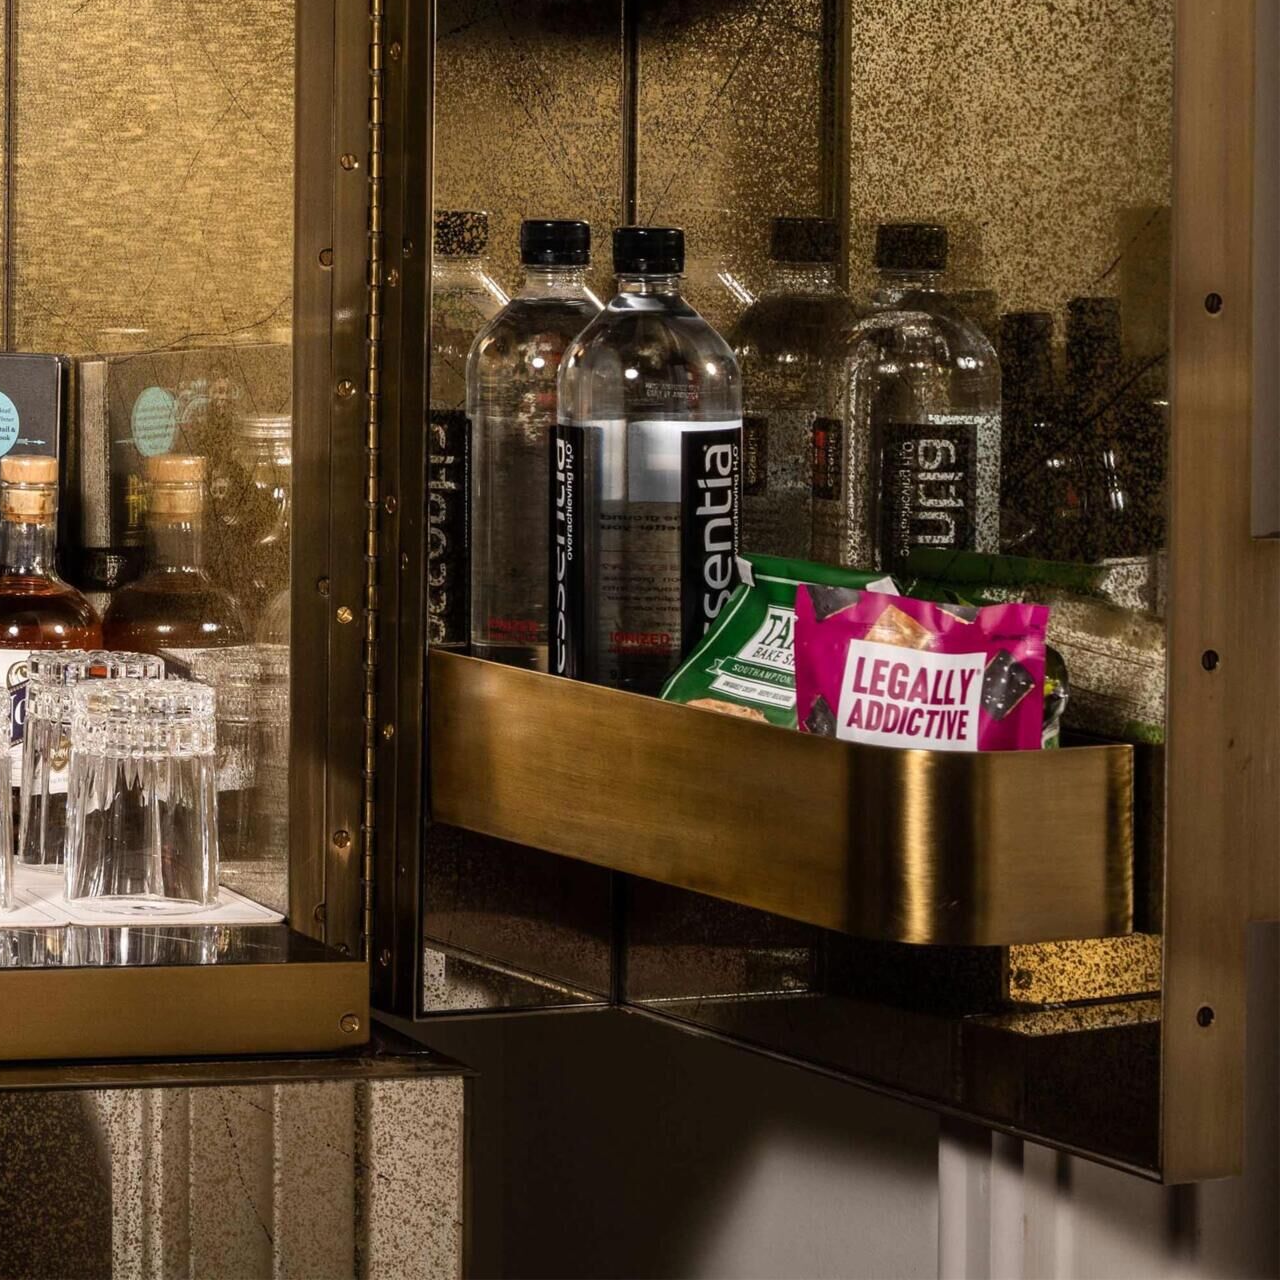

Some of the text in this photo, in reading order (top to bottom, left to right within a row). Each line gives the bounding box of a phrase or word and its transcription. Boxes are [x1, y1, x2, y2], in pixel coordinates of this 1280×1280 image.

[696, 444, 732, 634] sentia
[609, 631, 672, 645] IONIZED
[752, 647, 780, 662] BAKE
[852, 656, 976, 706] LEGALLY
[846, 698, 970, 740] ADDICTIVE
